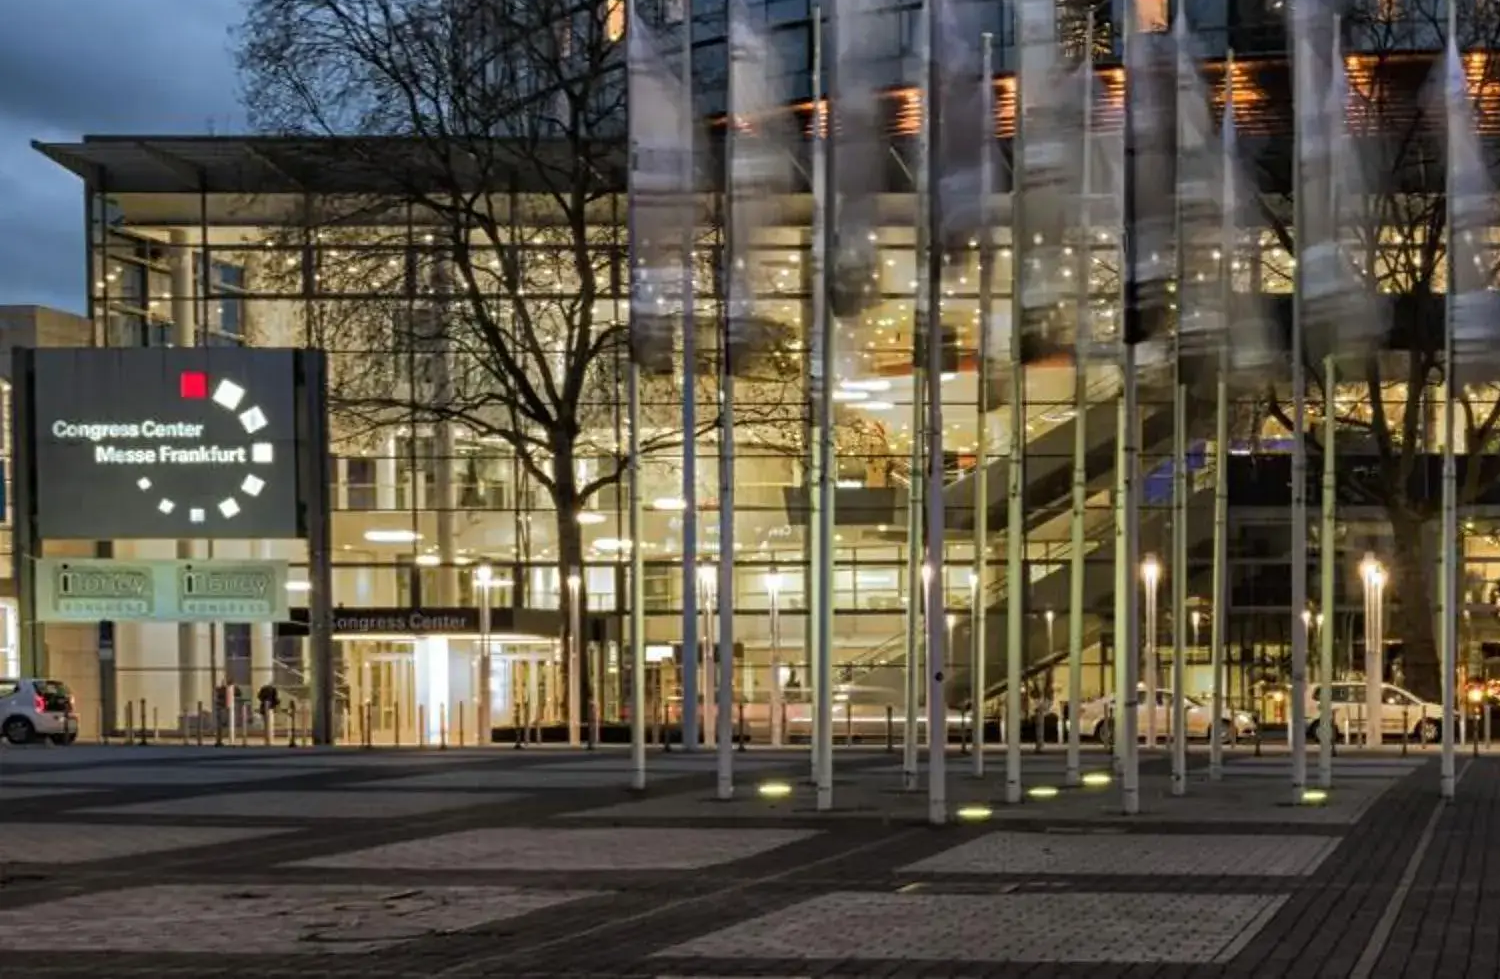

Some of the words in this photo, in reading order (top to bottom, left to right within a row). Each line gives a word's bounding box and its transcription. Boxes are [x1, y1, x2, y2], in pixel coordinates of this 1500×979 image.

[52, 420, 139, 441] Congress
[141, 420, 204, 438] Center
[95, 445, 156, 463] Messe
[159, 444, 246, 463] Frankfurt
[409, 612, 466, 629] Center
